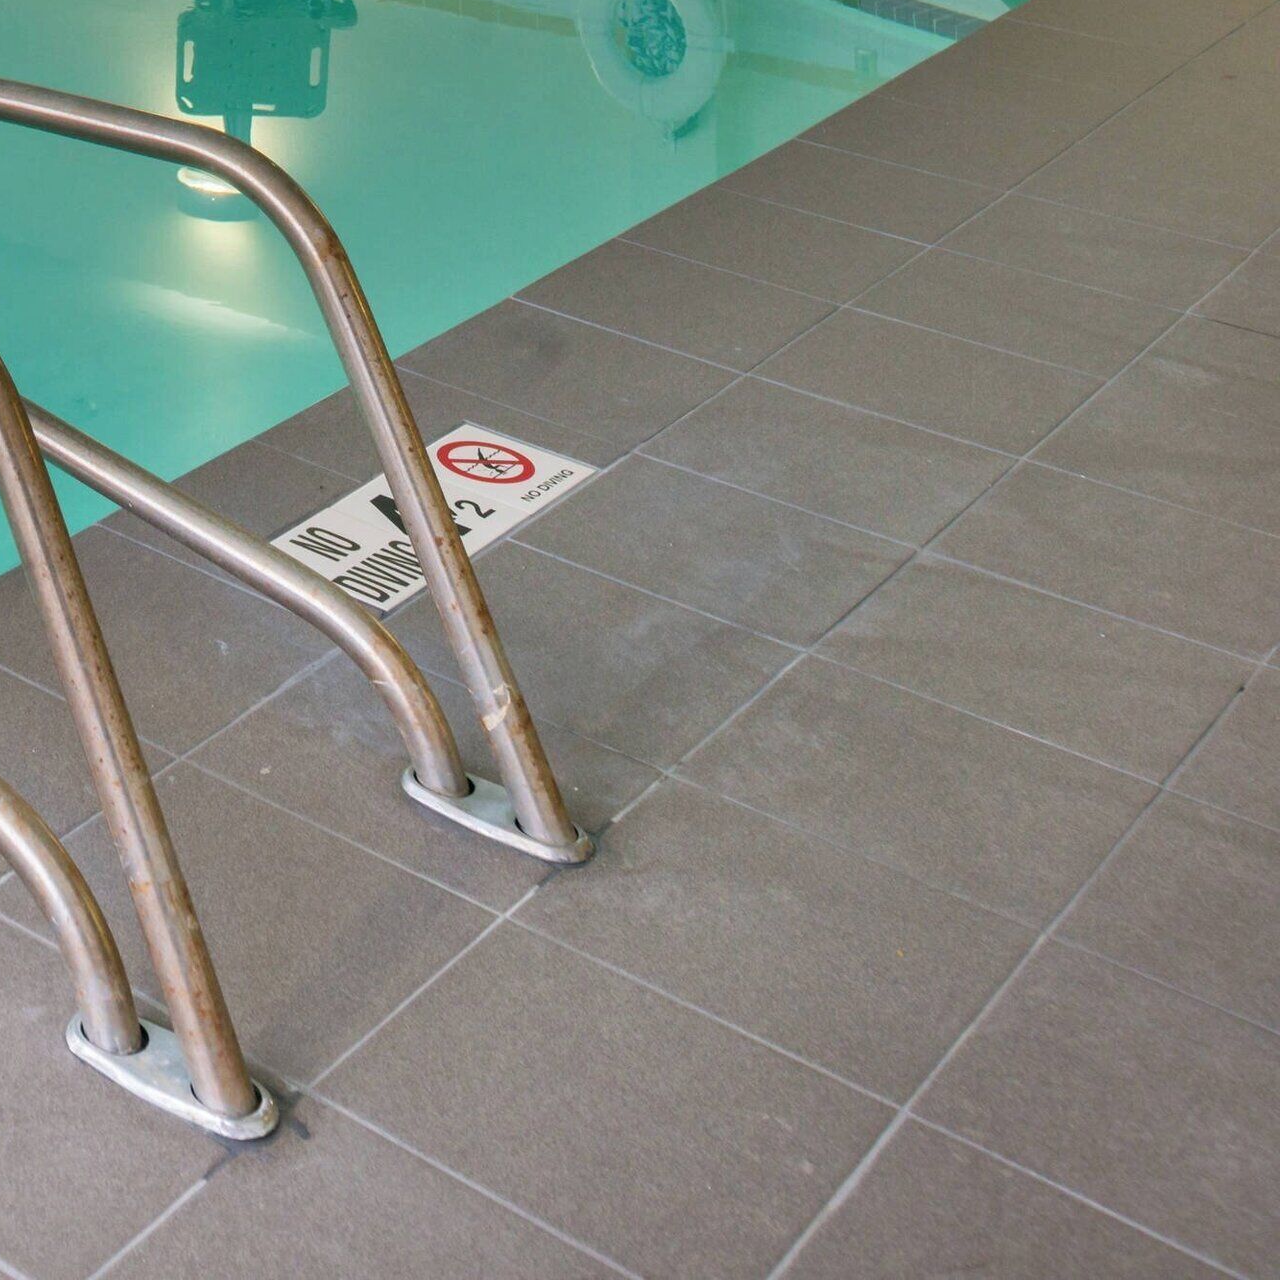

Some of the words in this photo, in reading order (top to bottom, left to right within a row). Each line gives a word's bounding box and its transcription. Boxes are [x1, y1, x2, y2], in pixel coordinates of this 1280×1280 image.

[520, 490, 541, 502] NO
[537, 469, 574, 491] DIVING
[289, 527, 361, 562] NO
